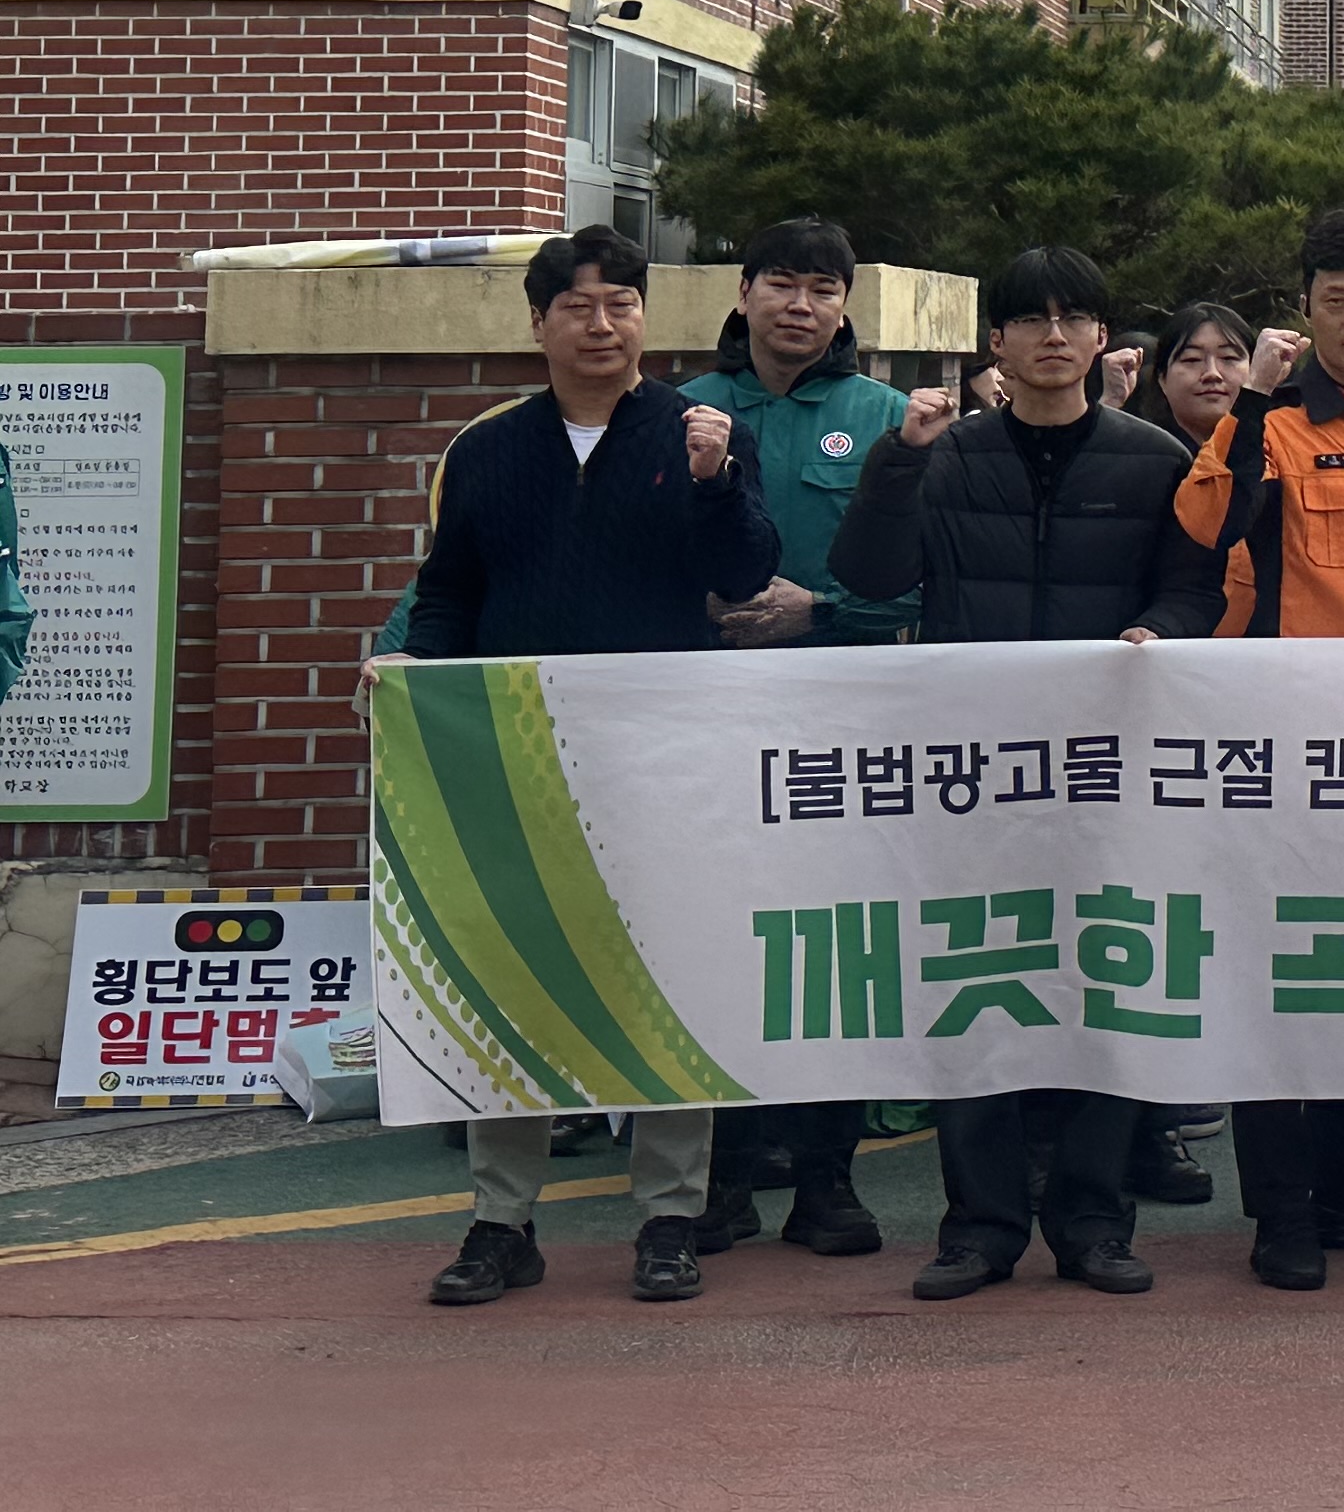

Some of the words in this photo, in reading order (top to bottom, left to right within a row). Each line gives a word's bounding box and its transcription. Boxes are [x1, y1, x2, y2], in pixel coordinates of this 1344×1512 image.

[18, 383, 34, 402] 및
[39, 383, 109, 401] 이용안내
[761, 735, 1124, 823] [불법광고물
[1150, 737, 1275, 809] 근절
[92, 959, 292, 1006] 횡단보도
[309, 956, 357, 1002] 앞
[752, 884, 1215, 1041] 깨끗한
